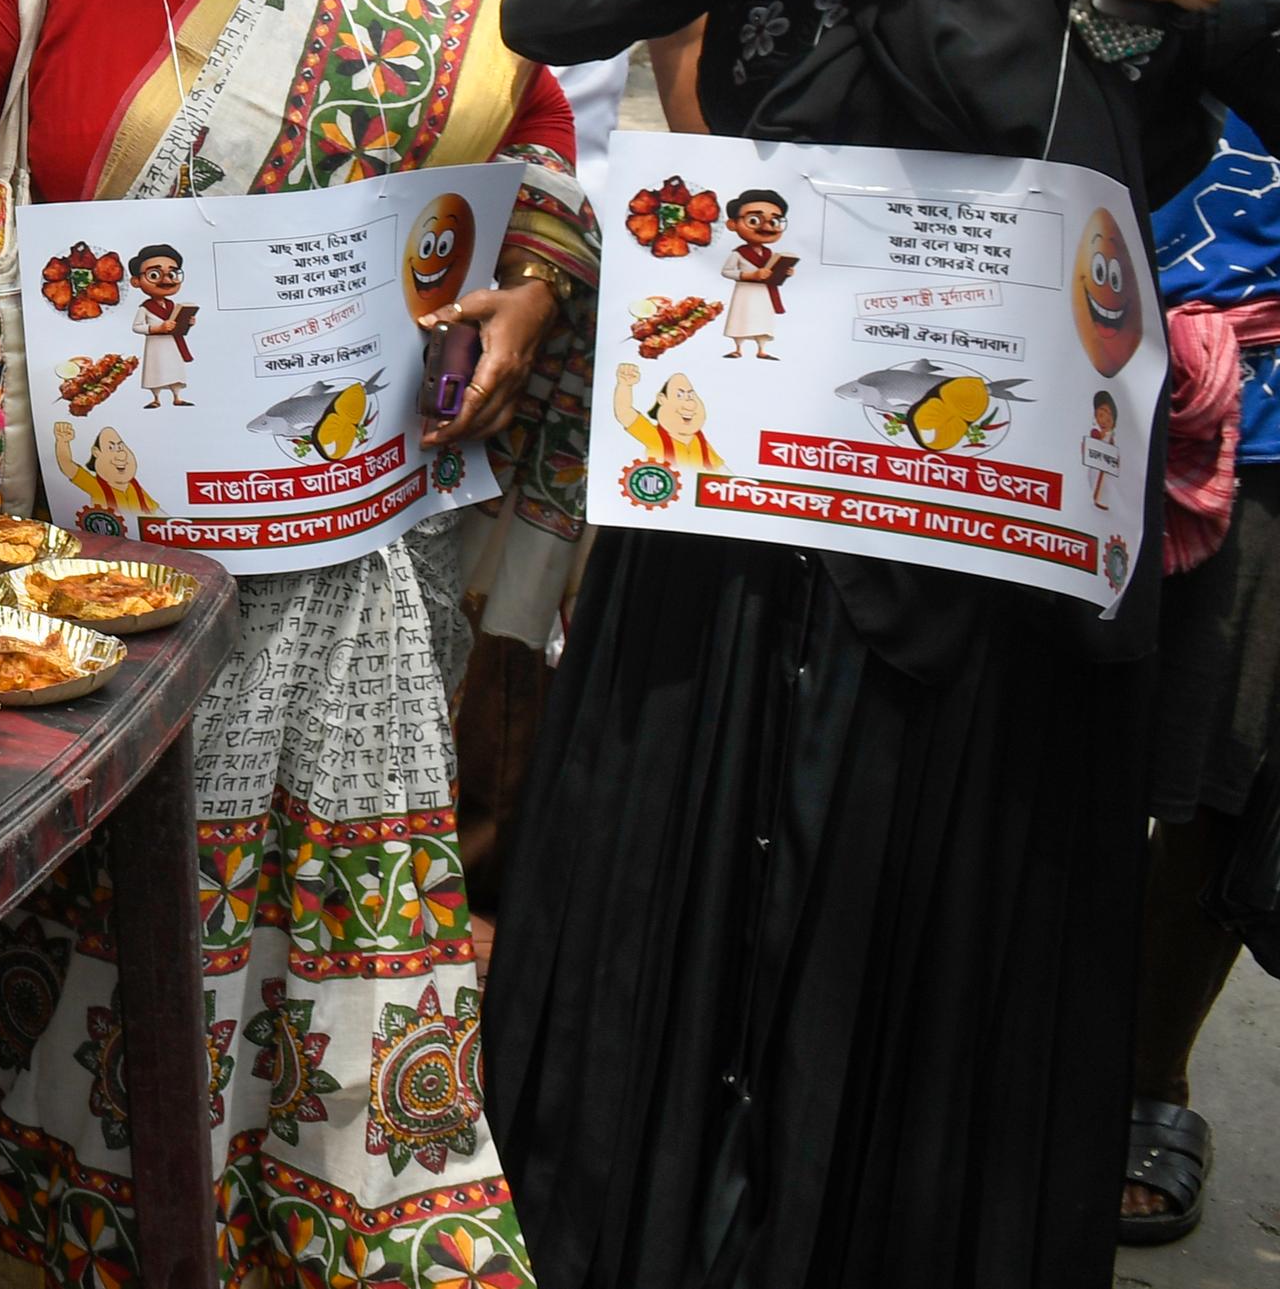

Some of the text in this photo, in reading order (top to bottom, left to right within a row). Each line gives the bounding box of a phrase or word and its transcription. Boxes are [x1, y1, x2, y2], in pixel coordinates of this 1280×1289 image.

[195, 472, 295, 503] বাঙালির
[299, 463, 364, 492] আমিষ
[365, 446, 401, 478] উৎসব
[768, 439, 1051, 505] বাঙালির আমিষ উৎসব
[146, 519, 262, 545] পশ্চিমবঙ্গ
[266, 514, 332, 543] প্রদেশ
[337, 502, 381, 531] INTUC
[381, 475, 421, 514] সেবাদল
[703, 476, 1089, 562] পশ্চিমবঙ্গ প্রদেশ INTUC সেবাদল
